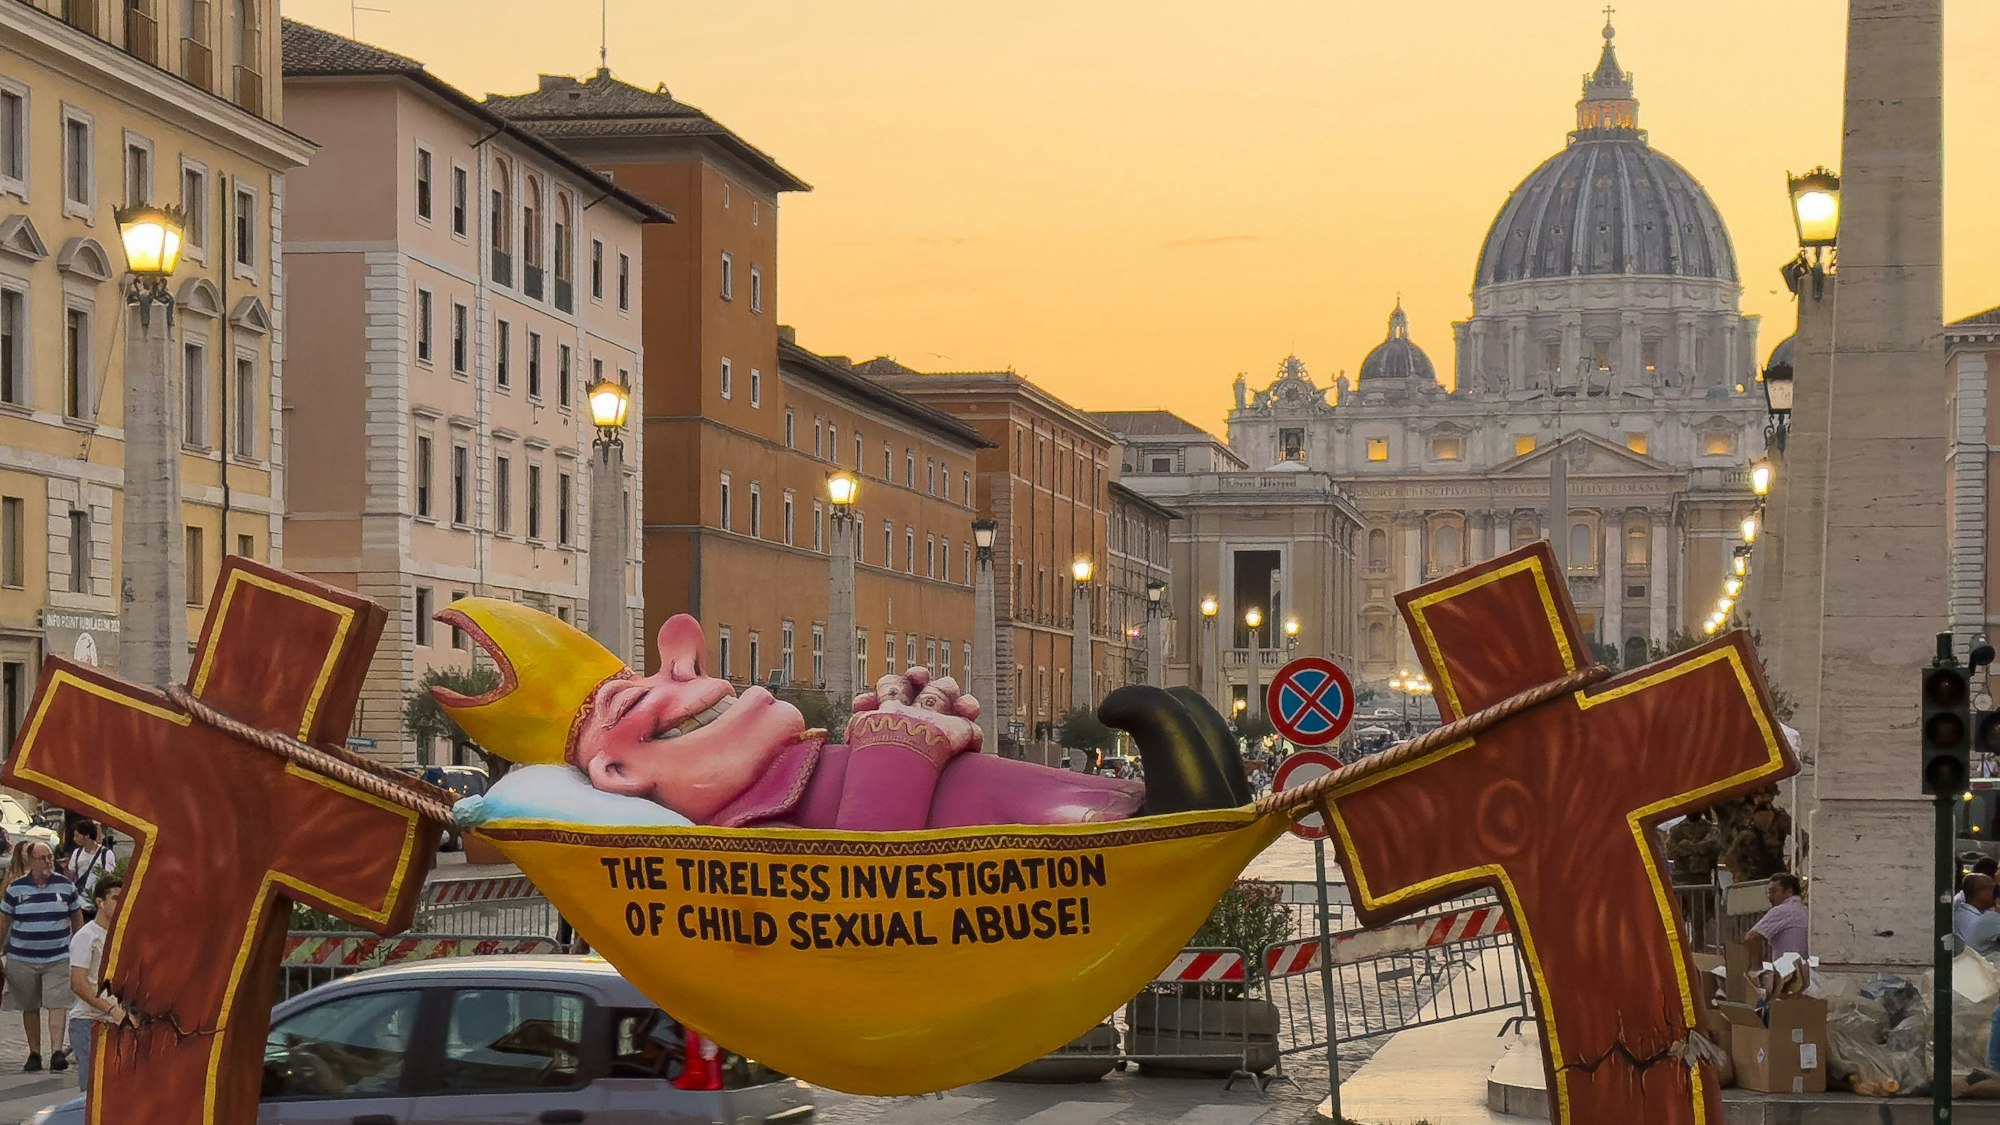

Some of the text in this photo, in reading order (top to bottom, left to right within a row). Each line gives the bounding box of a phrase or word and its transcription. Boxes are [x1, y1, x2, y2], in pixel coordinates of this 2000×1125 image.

[46, 614, 60, 627] INFO
[62, 615, 79, 629] POINT
[600, 854, 1107, 902] THE TIRELESS INVESTIGATION
[625, 897, 1091, 951] OF CHILD SEXUAL ABUSE!
